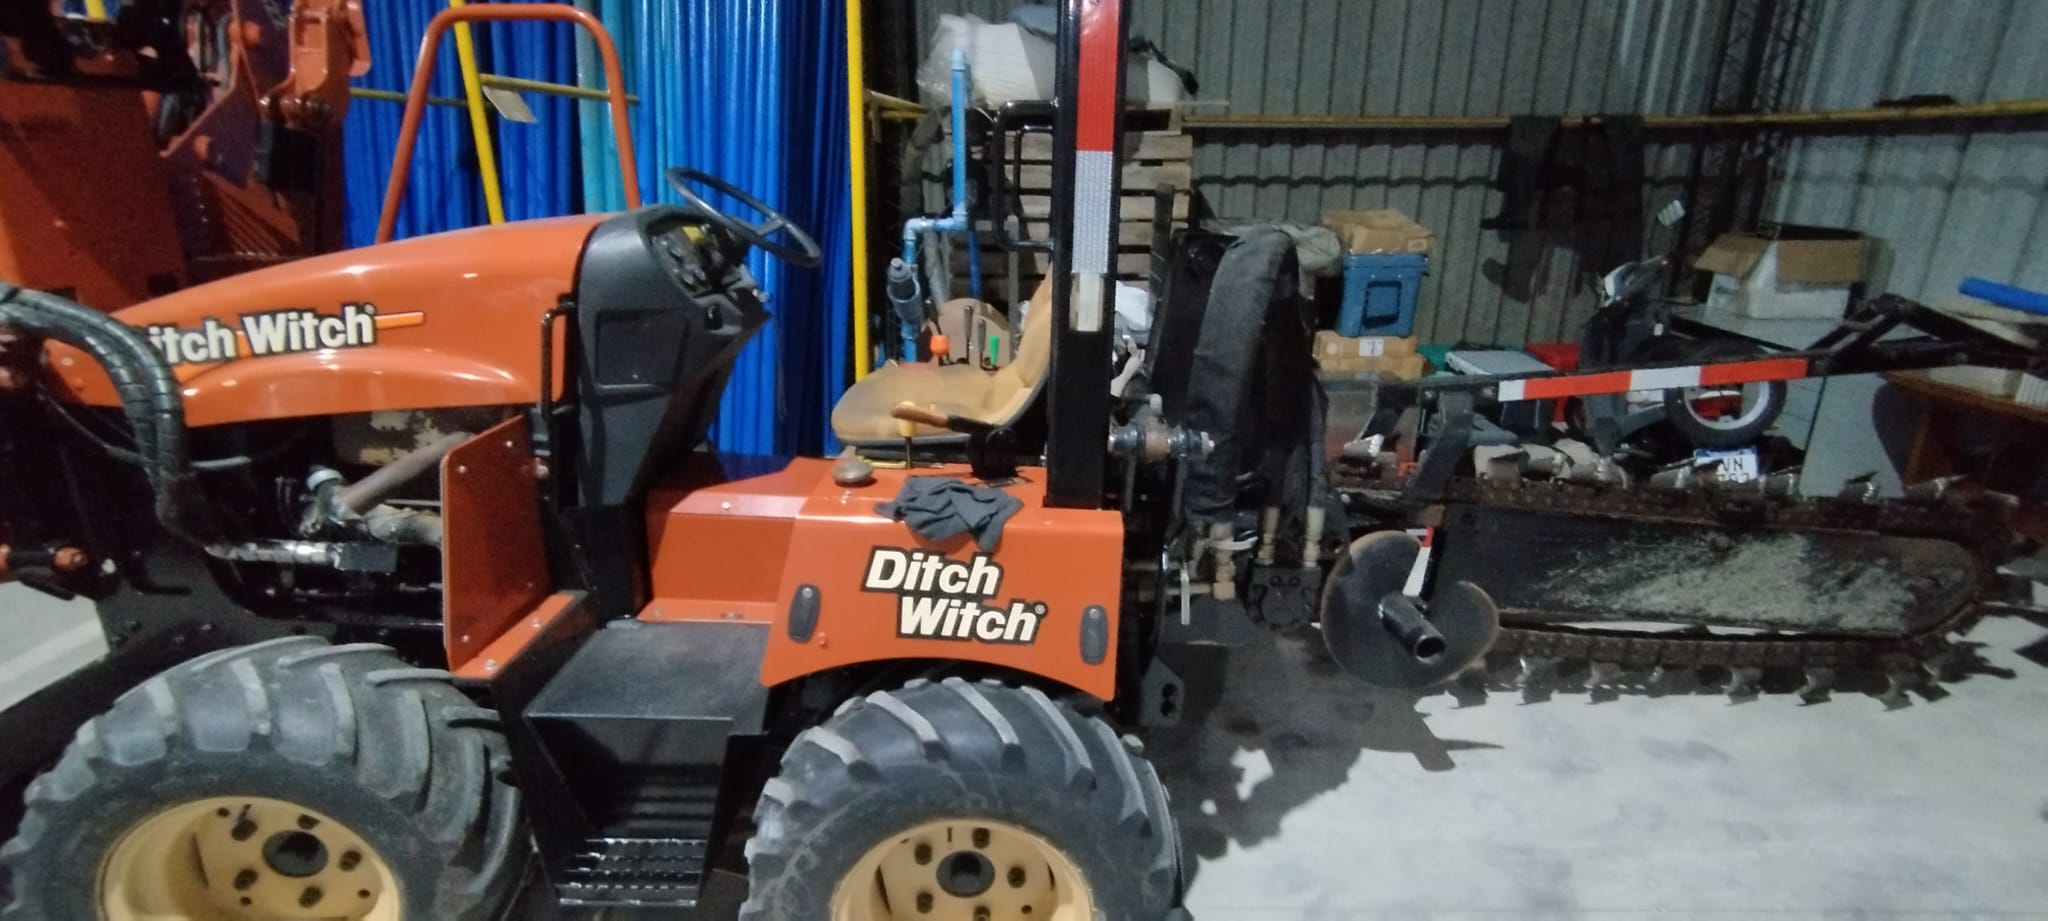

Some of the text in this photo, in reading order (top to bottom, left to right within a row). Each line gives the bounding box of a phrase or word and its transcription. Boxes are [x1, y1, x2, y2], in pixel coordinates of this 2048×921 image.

[149, 304, 375, 364] itch Witch
[865, 549, 1000, 595] Ditch
[900, 596, 1038, 641] Witch
